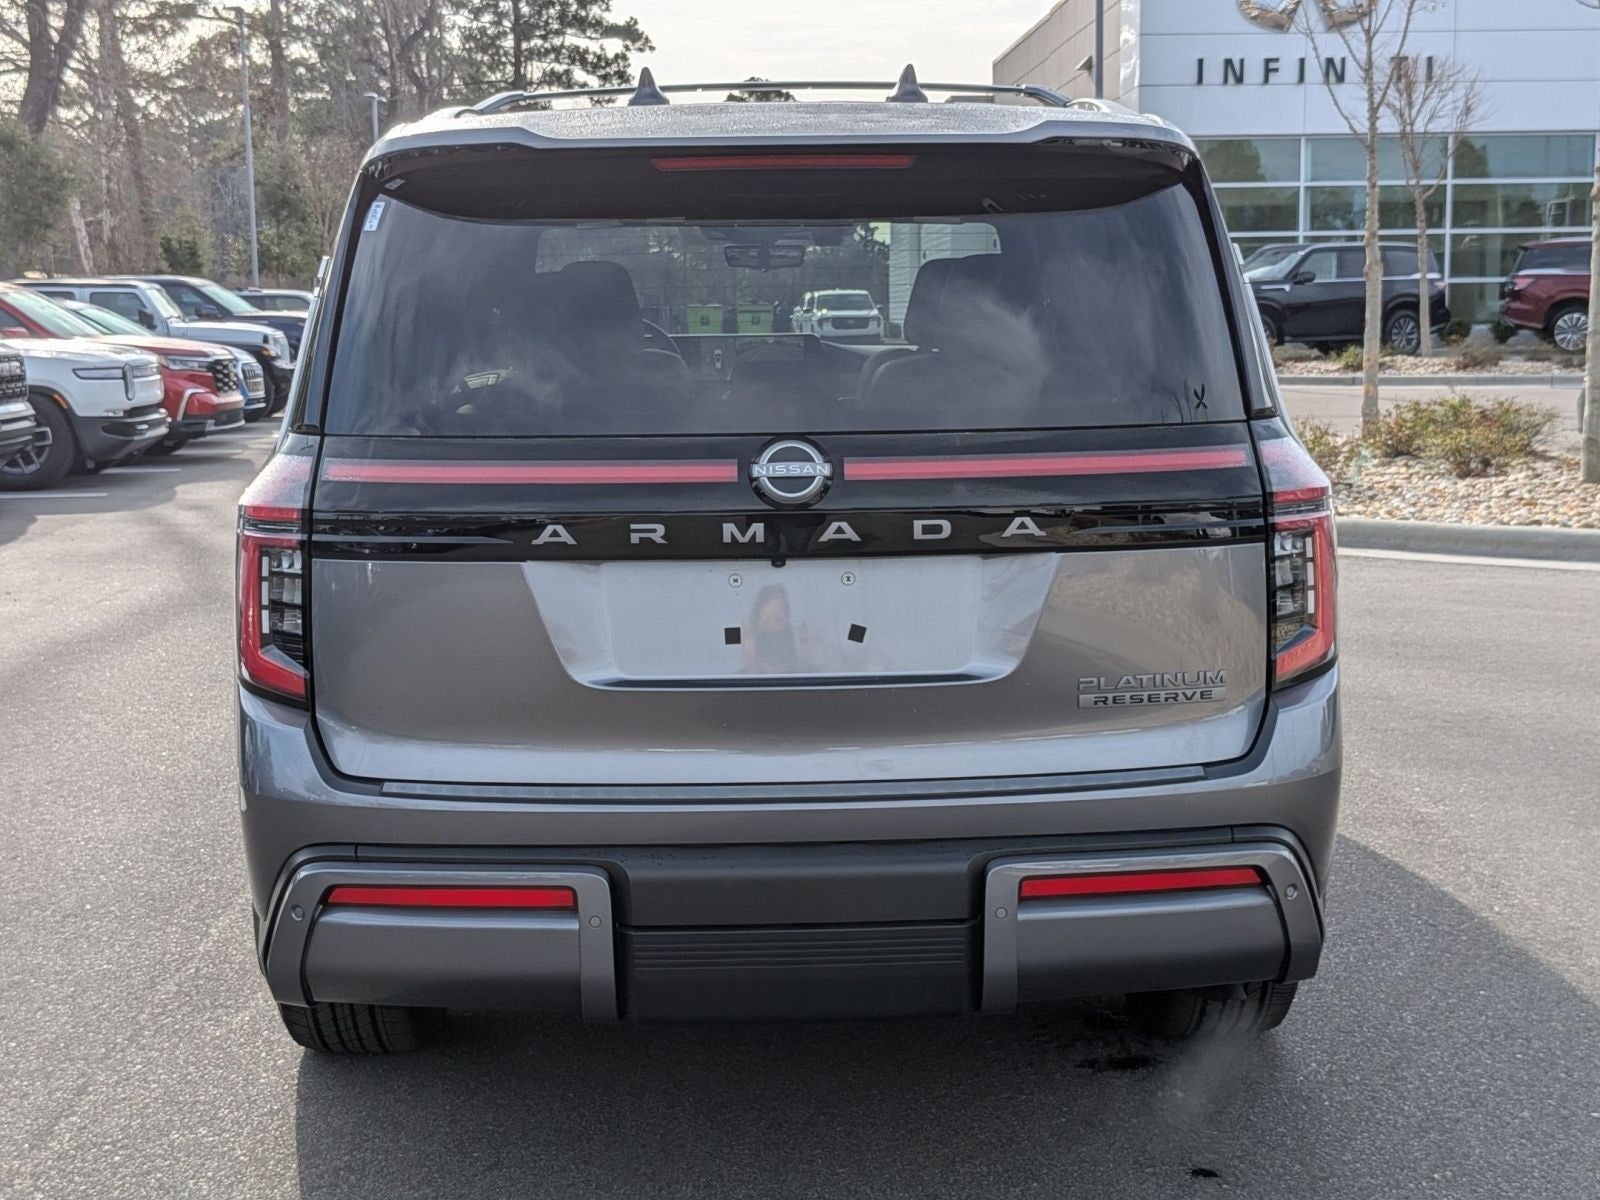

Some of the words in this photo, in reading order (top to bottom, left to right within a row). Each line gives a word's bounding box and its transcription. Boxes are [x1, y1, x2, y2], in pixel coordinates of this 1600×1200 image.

[1197, 56, 1434, 86] INFINTI
[755, 464, 829, 476] NISSAN
[530, 516, 1047, 546] ARMADA
[1077, 669, 1227, 692] PLATINUM
[1093, 689, 1214, 706] RESERVE
